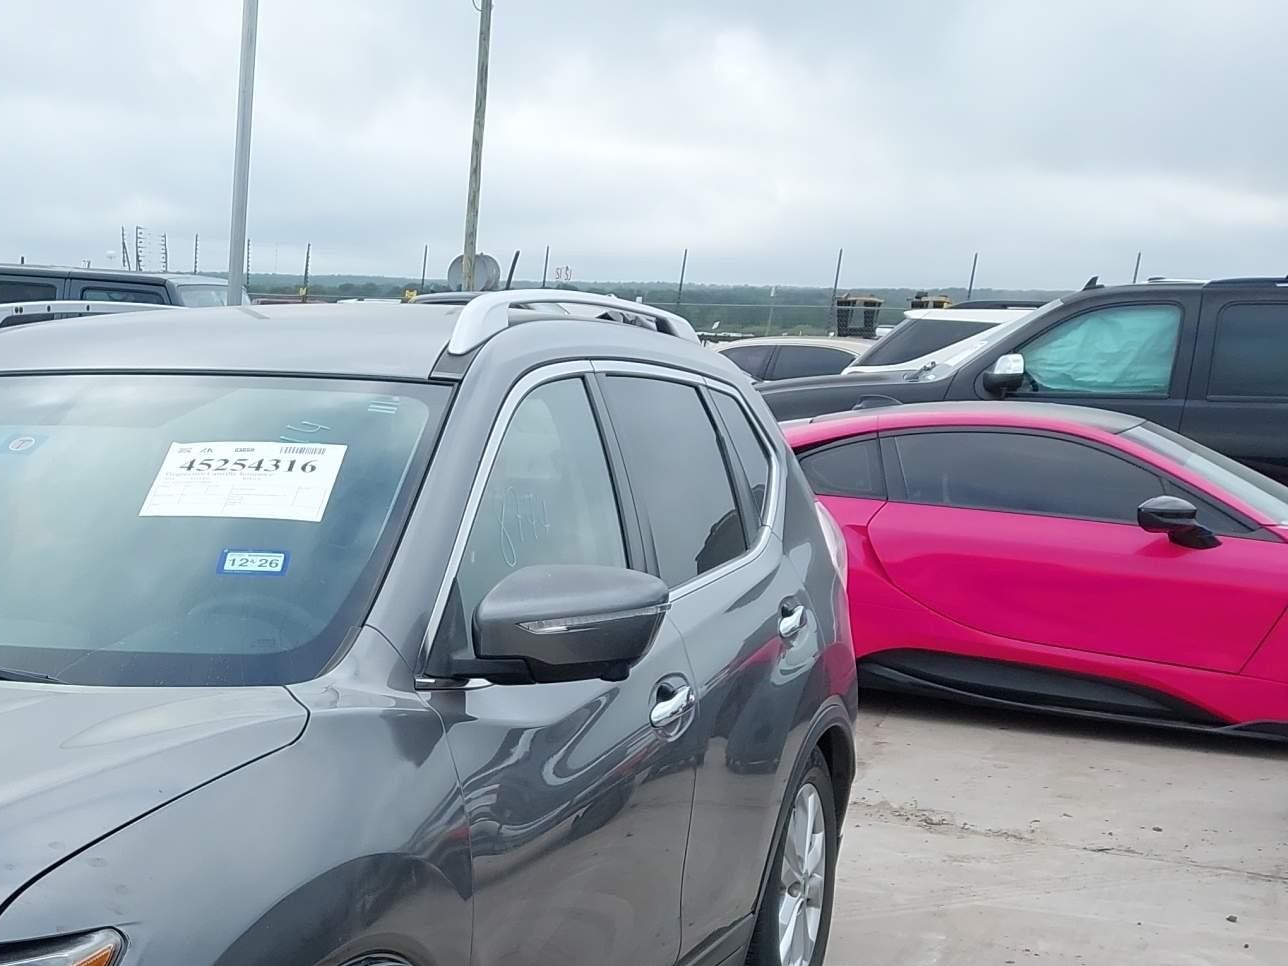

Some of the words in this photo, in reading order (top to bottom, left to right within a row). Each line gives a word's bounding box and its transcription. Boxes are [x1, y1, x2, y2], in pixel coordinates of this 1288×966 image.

[178, 458, 319, 474] 45254316
[228, 557, 250, 568] 12
[257, 557, 280, 569] 26
